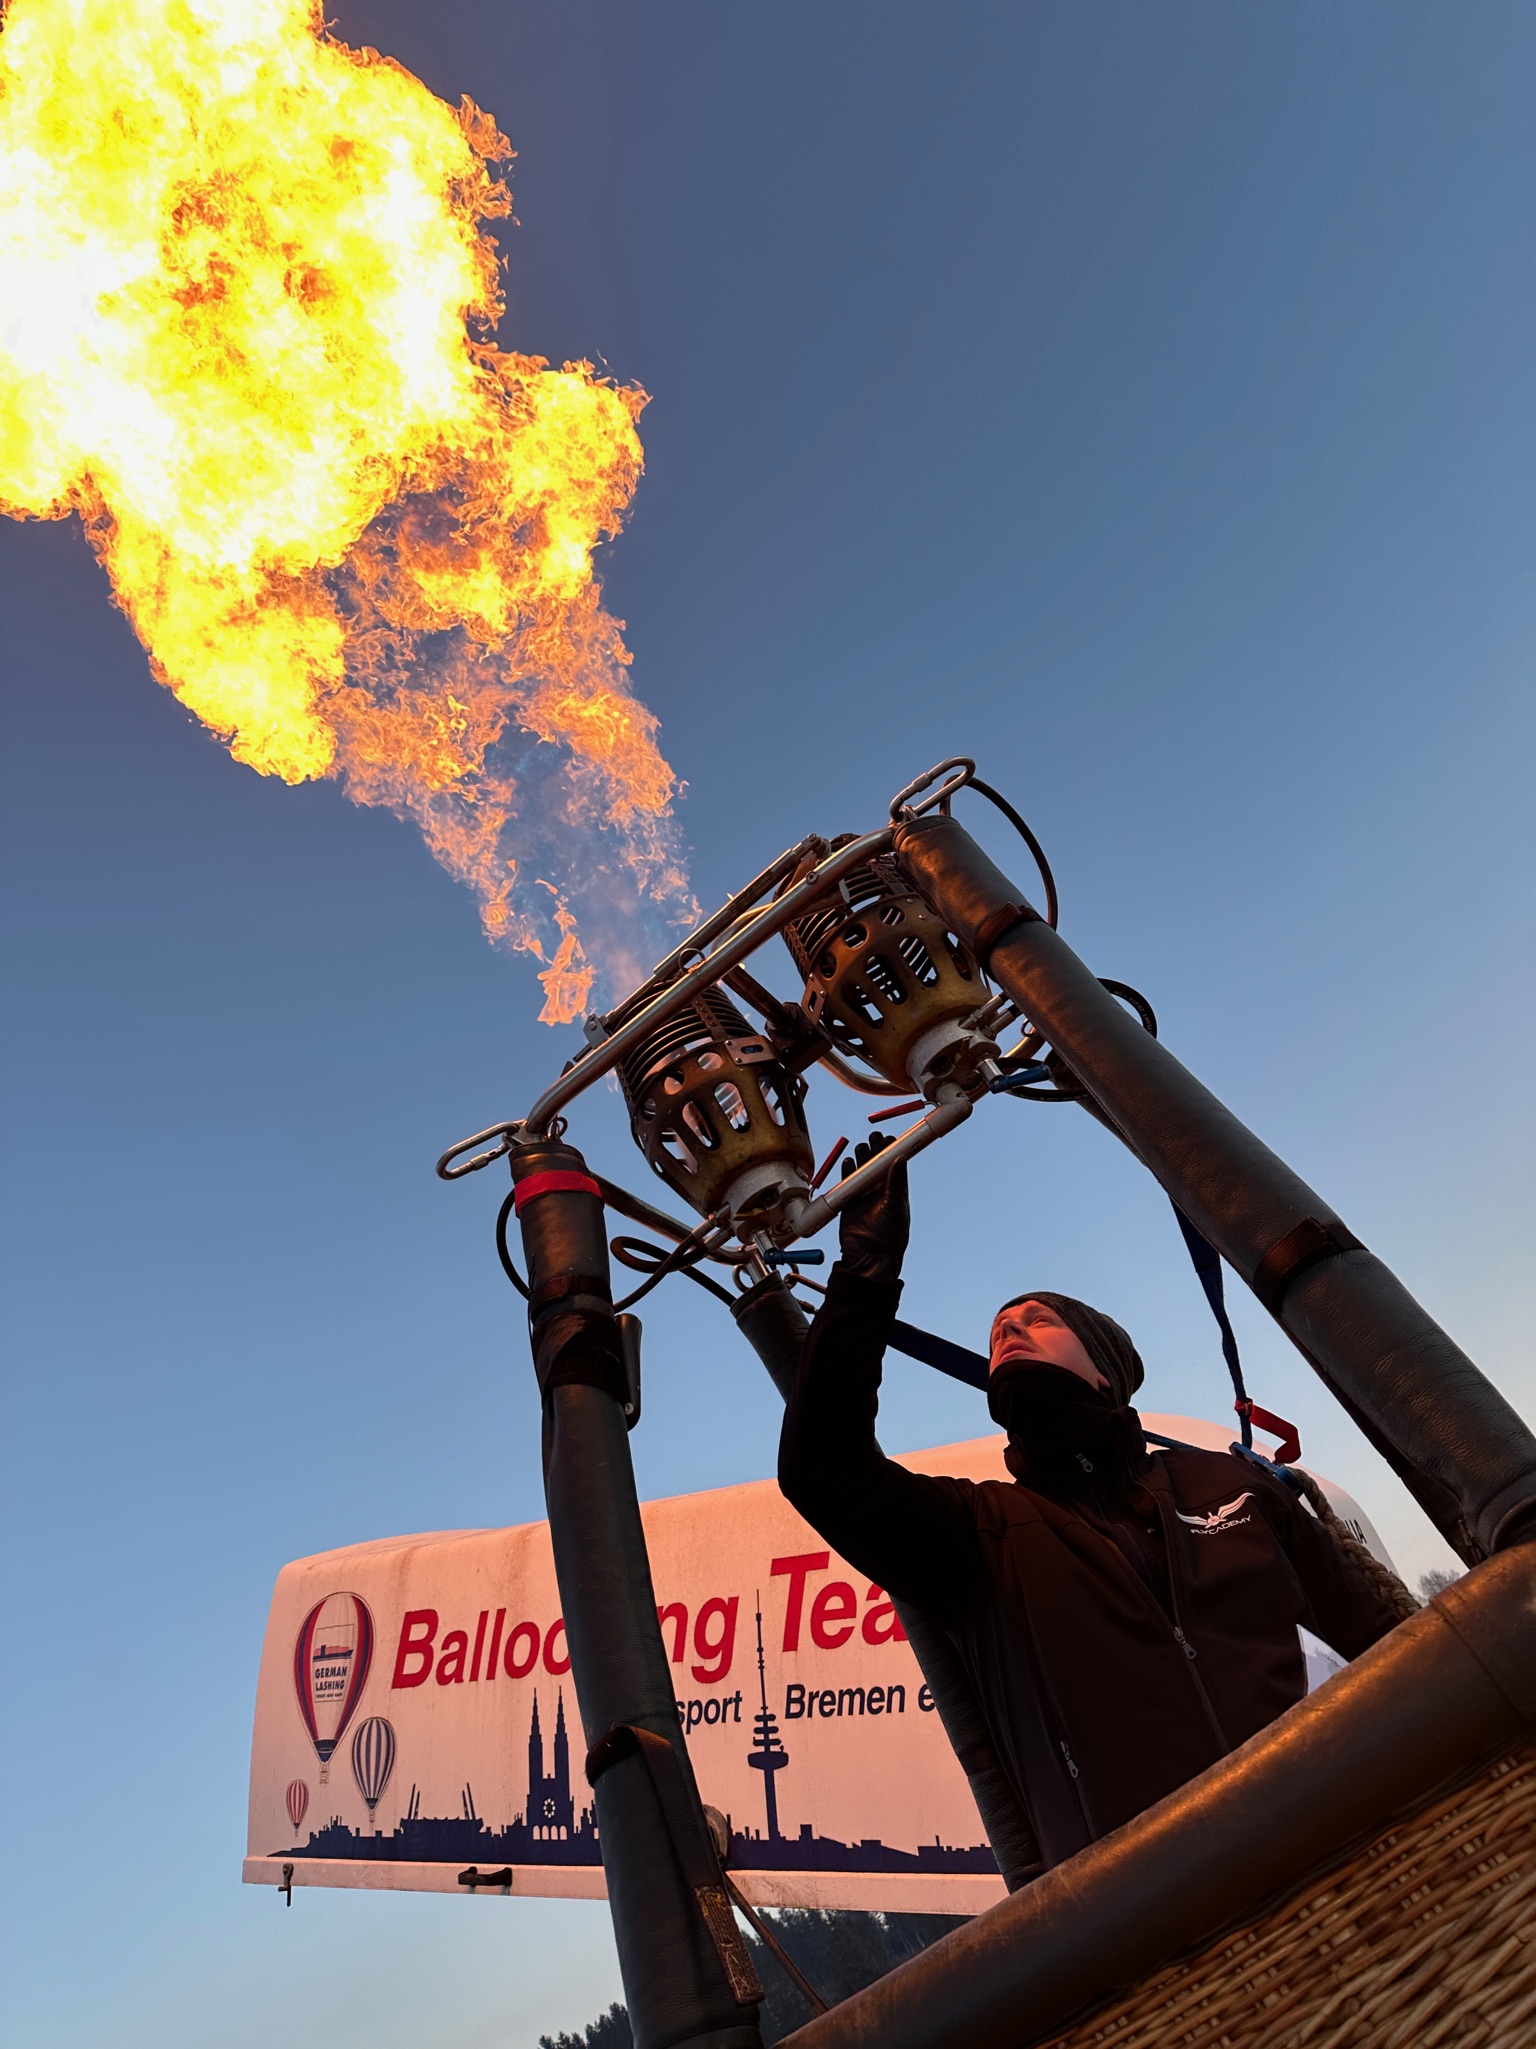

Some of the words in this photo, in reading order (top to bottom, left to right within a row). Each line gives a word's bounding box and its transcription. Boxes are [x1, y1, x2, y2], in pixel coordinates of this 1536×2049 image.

[1190, 1514, 1251, 1535] FLYCADEMY
[391, 1596, 740, 1690] Balloong
[769, 1551, 910, 1653] Tea
[315, 1666, 348, 1679] GERMAN
[315, 1680, 345, 1691] LASHING
[785, 1684, 905, 1719] Bremen
